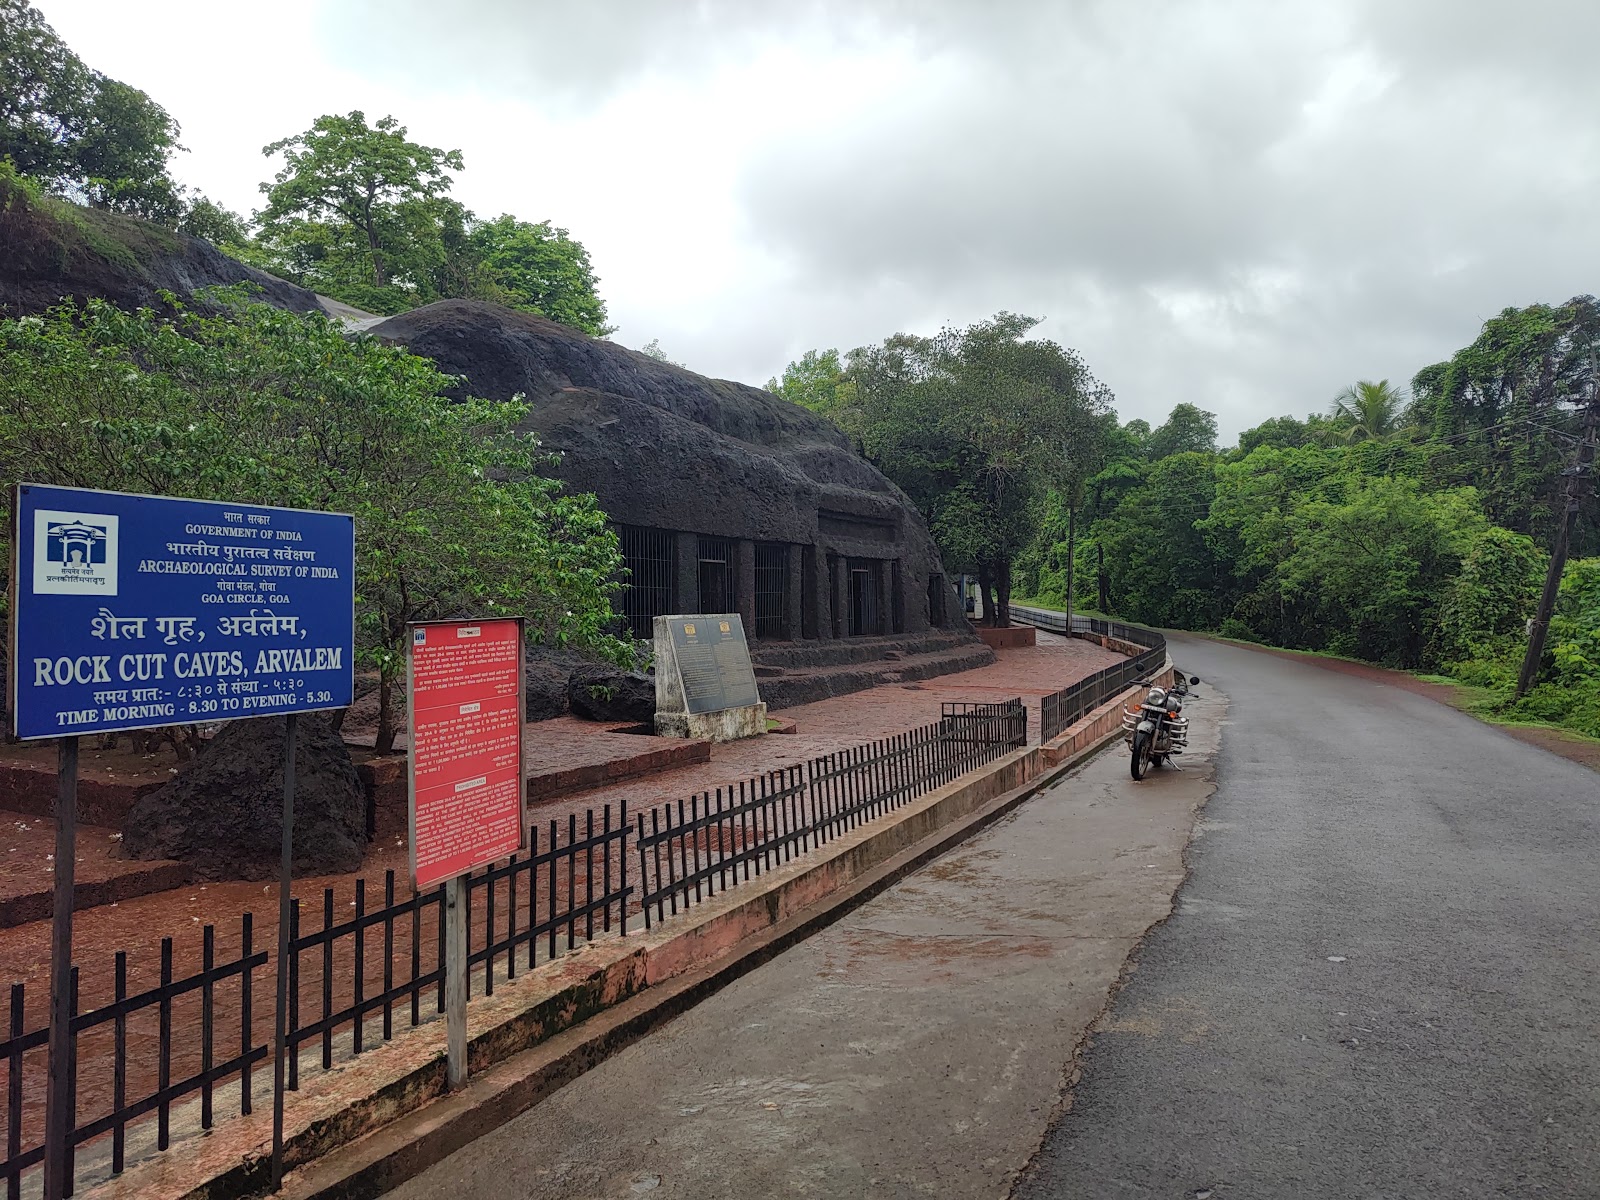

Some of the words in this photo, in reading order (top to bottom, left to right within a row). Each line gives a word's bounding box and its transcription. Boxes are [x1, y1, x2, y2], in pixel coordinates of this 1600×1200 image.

[224, 512, 243, 522] भारत
[248, 515, 270, 523] सरकार
[186, 524, 257, 538] GOVERNMENT
[261, 530, 273, 538] OF
[276, 531, 302, 540] INDIA
[167, 540, 220, 556] भारतीय
[224, 546, 270, 561] पुरातत्व
[274, 546, 315, 561] सर्वेक्षण
[138, 559, 247, 575] ARCHAEOLOGICAL
[251, 565, 292, 576] SURVEY
[295, 566, 308, 576] OF
[312, 567, 338, 578] INDIA
[217, 580, 234, 590] गोवा
[237, 581, 256, 592] मंडल,
[260, 581, 276, 591] गोवा
[202, 594, 224, 603] GOA
[227, 595, 266, 603] CIRCLE,
[270, 595, 289, 603] GOA
[92, 608, 147, 640] शैल
[156, 618, 205, 645] गृह,
[217, 609, 306, 639] अर्वलेम,
[34, 656, 111, 686] ROCK
[120, 654, 166, 681] CUT
[174, 651, 248, 678] CAVES,
[254, 648, 342, 673] ARVALEM
[94, 690, 128, 704] समय
[178, 686, 212, 697] ८:३०
[217, 681, 228, 694] से
[231, 679, 258, 694] संध्या
[56, 710, 98, 725] TIME
[104, 704, 174, 721] MORNING
[189, 700, 217, 713] 8.30
[222, 698, 239, 710] TO
[243, 694, 296, 708] EVENING
